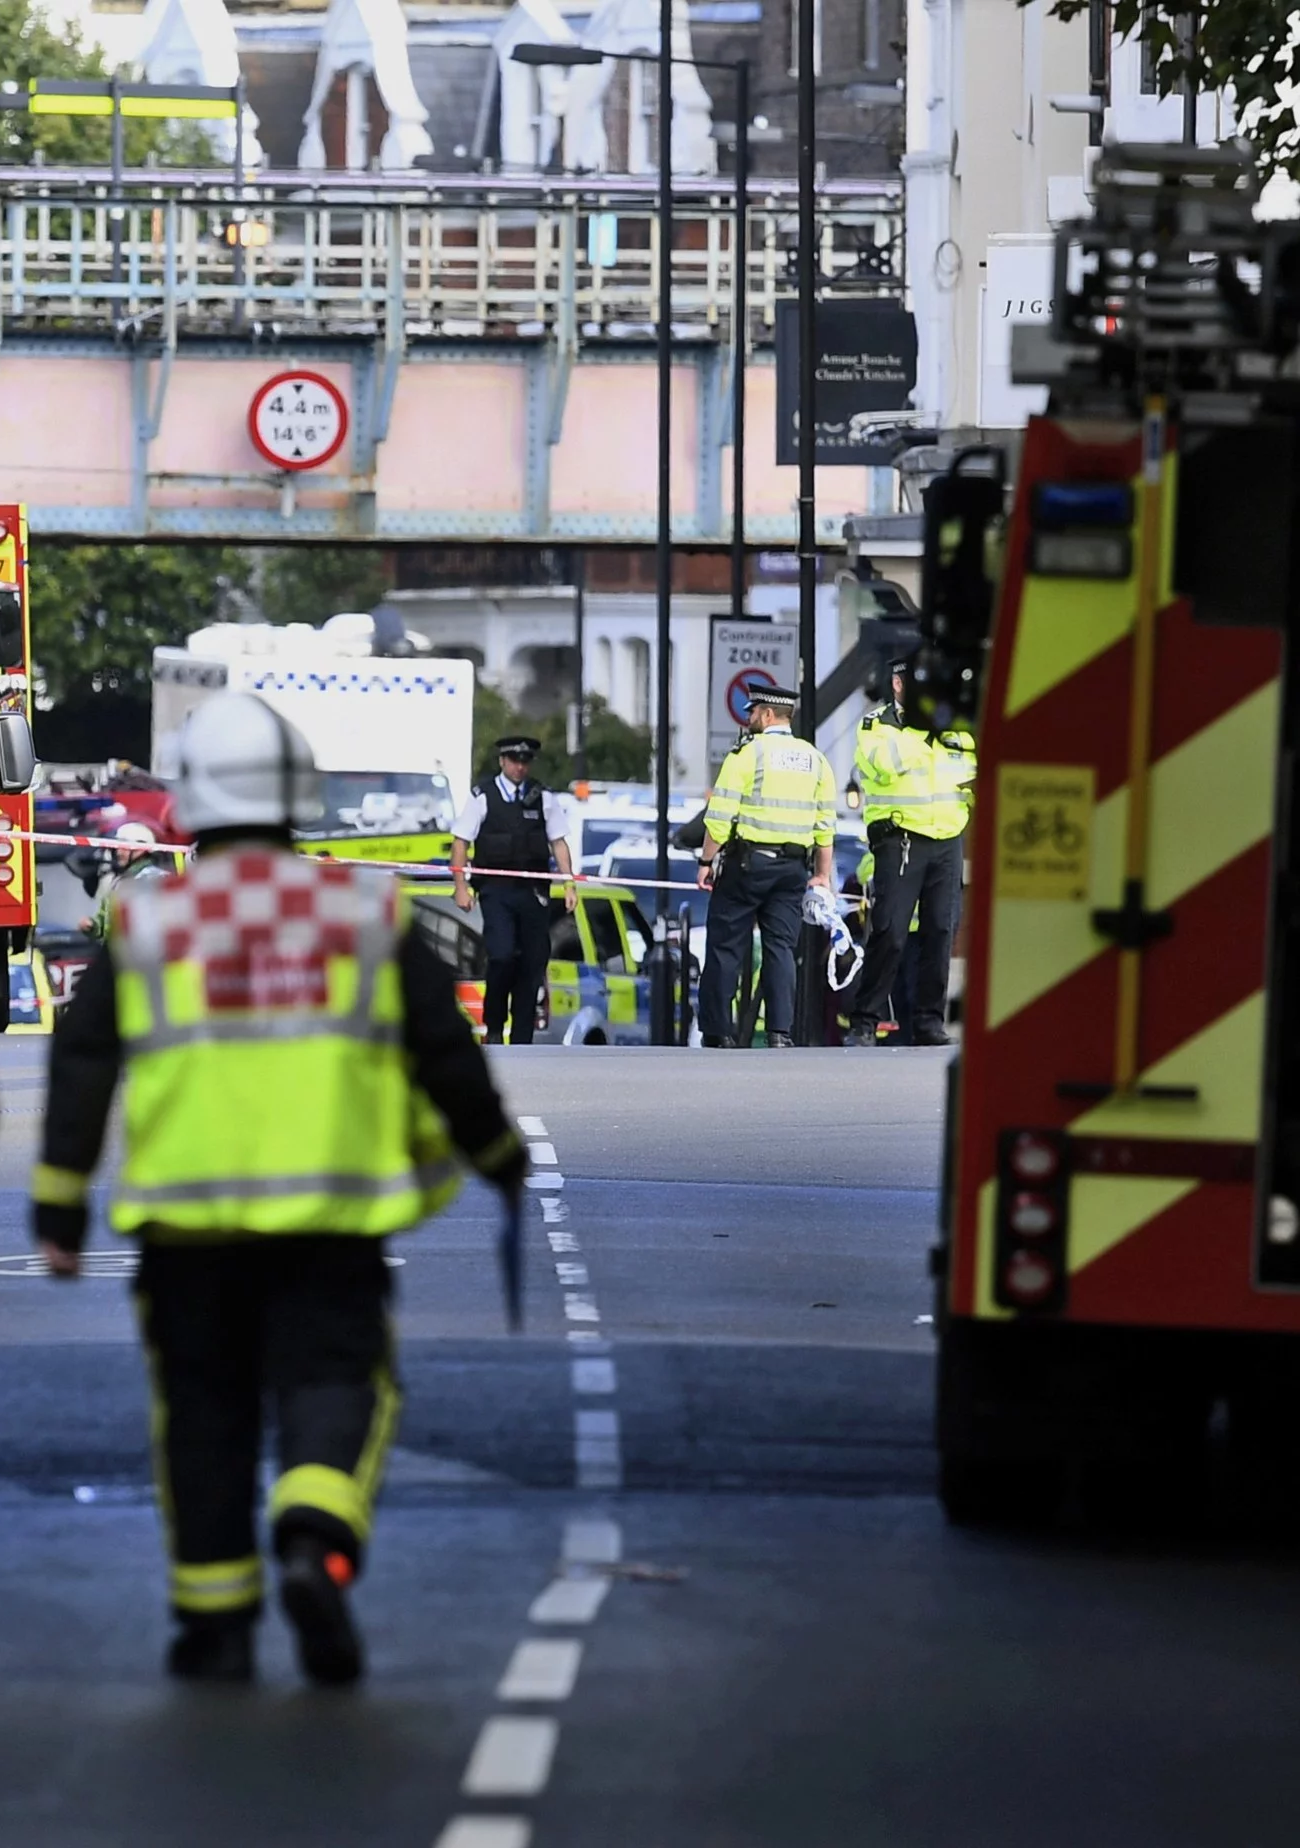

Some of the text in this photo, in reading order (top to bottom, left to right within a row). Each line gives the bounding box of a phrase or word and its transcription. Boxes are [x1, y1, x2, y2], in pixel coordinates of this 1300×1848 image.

[1001, 299, 1057, 318] JIGS
[863, 369, 906, 382] Kitchen
[718, 627, 794, 645] Controlled
[728, 647, 780, 666] ZONE
